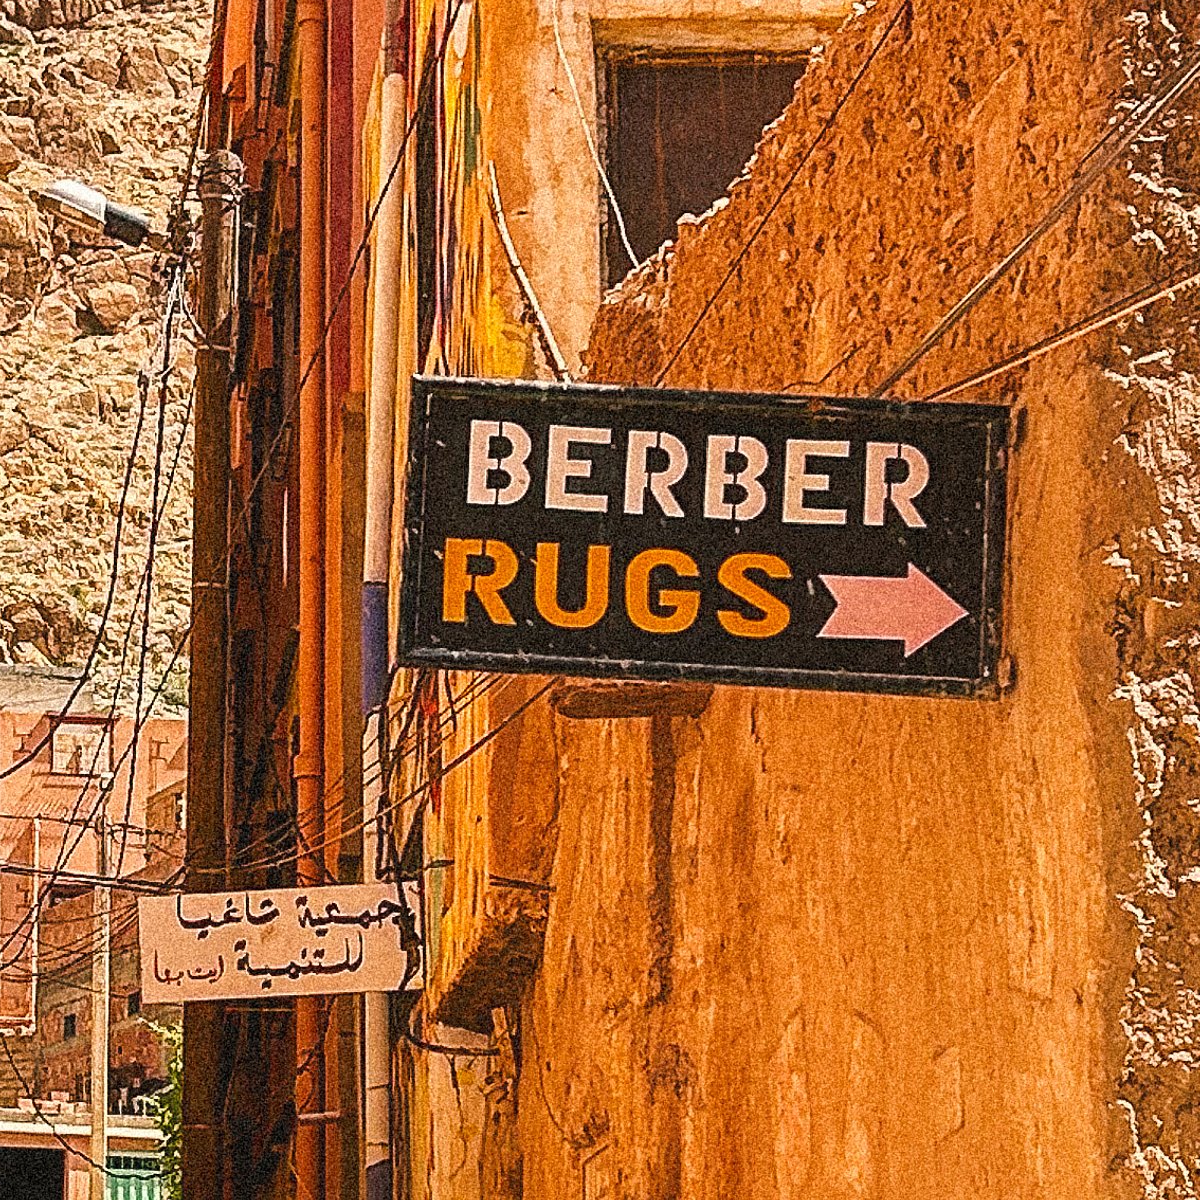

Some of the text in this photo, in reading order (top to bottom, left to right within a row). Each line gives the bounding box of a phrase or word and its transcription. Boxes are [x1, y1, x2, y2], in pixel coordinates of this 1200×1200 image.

[466, 419, 930, 529] BERBER
[442, 537, 793, 638] RUGS
[295, 895, 403, 938] جمعية
[234, 930, 363, 990] للتنمية
